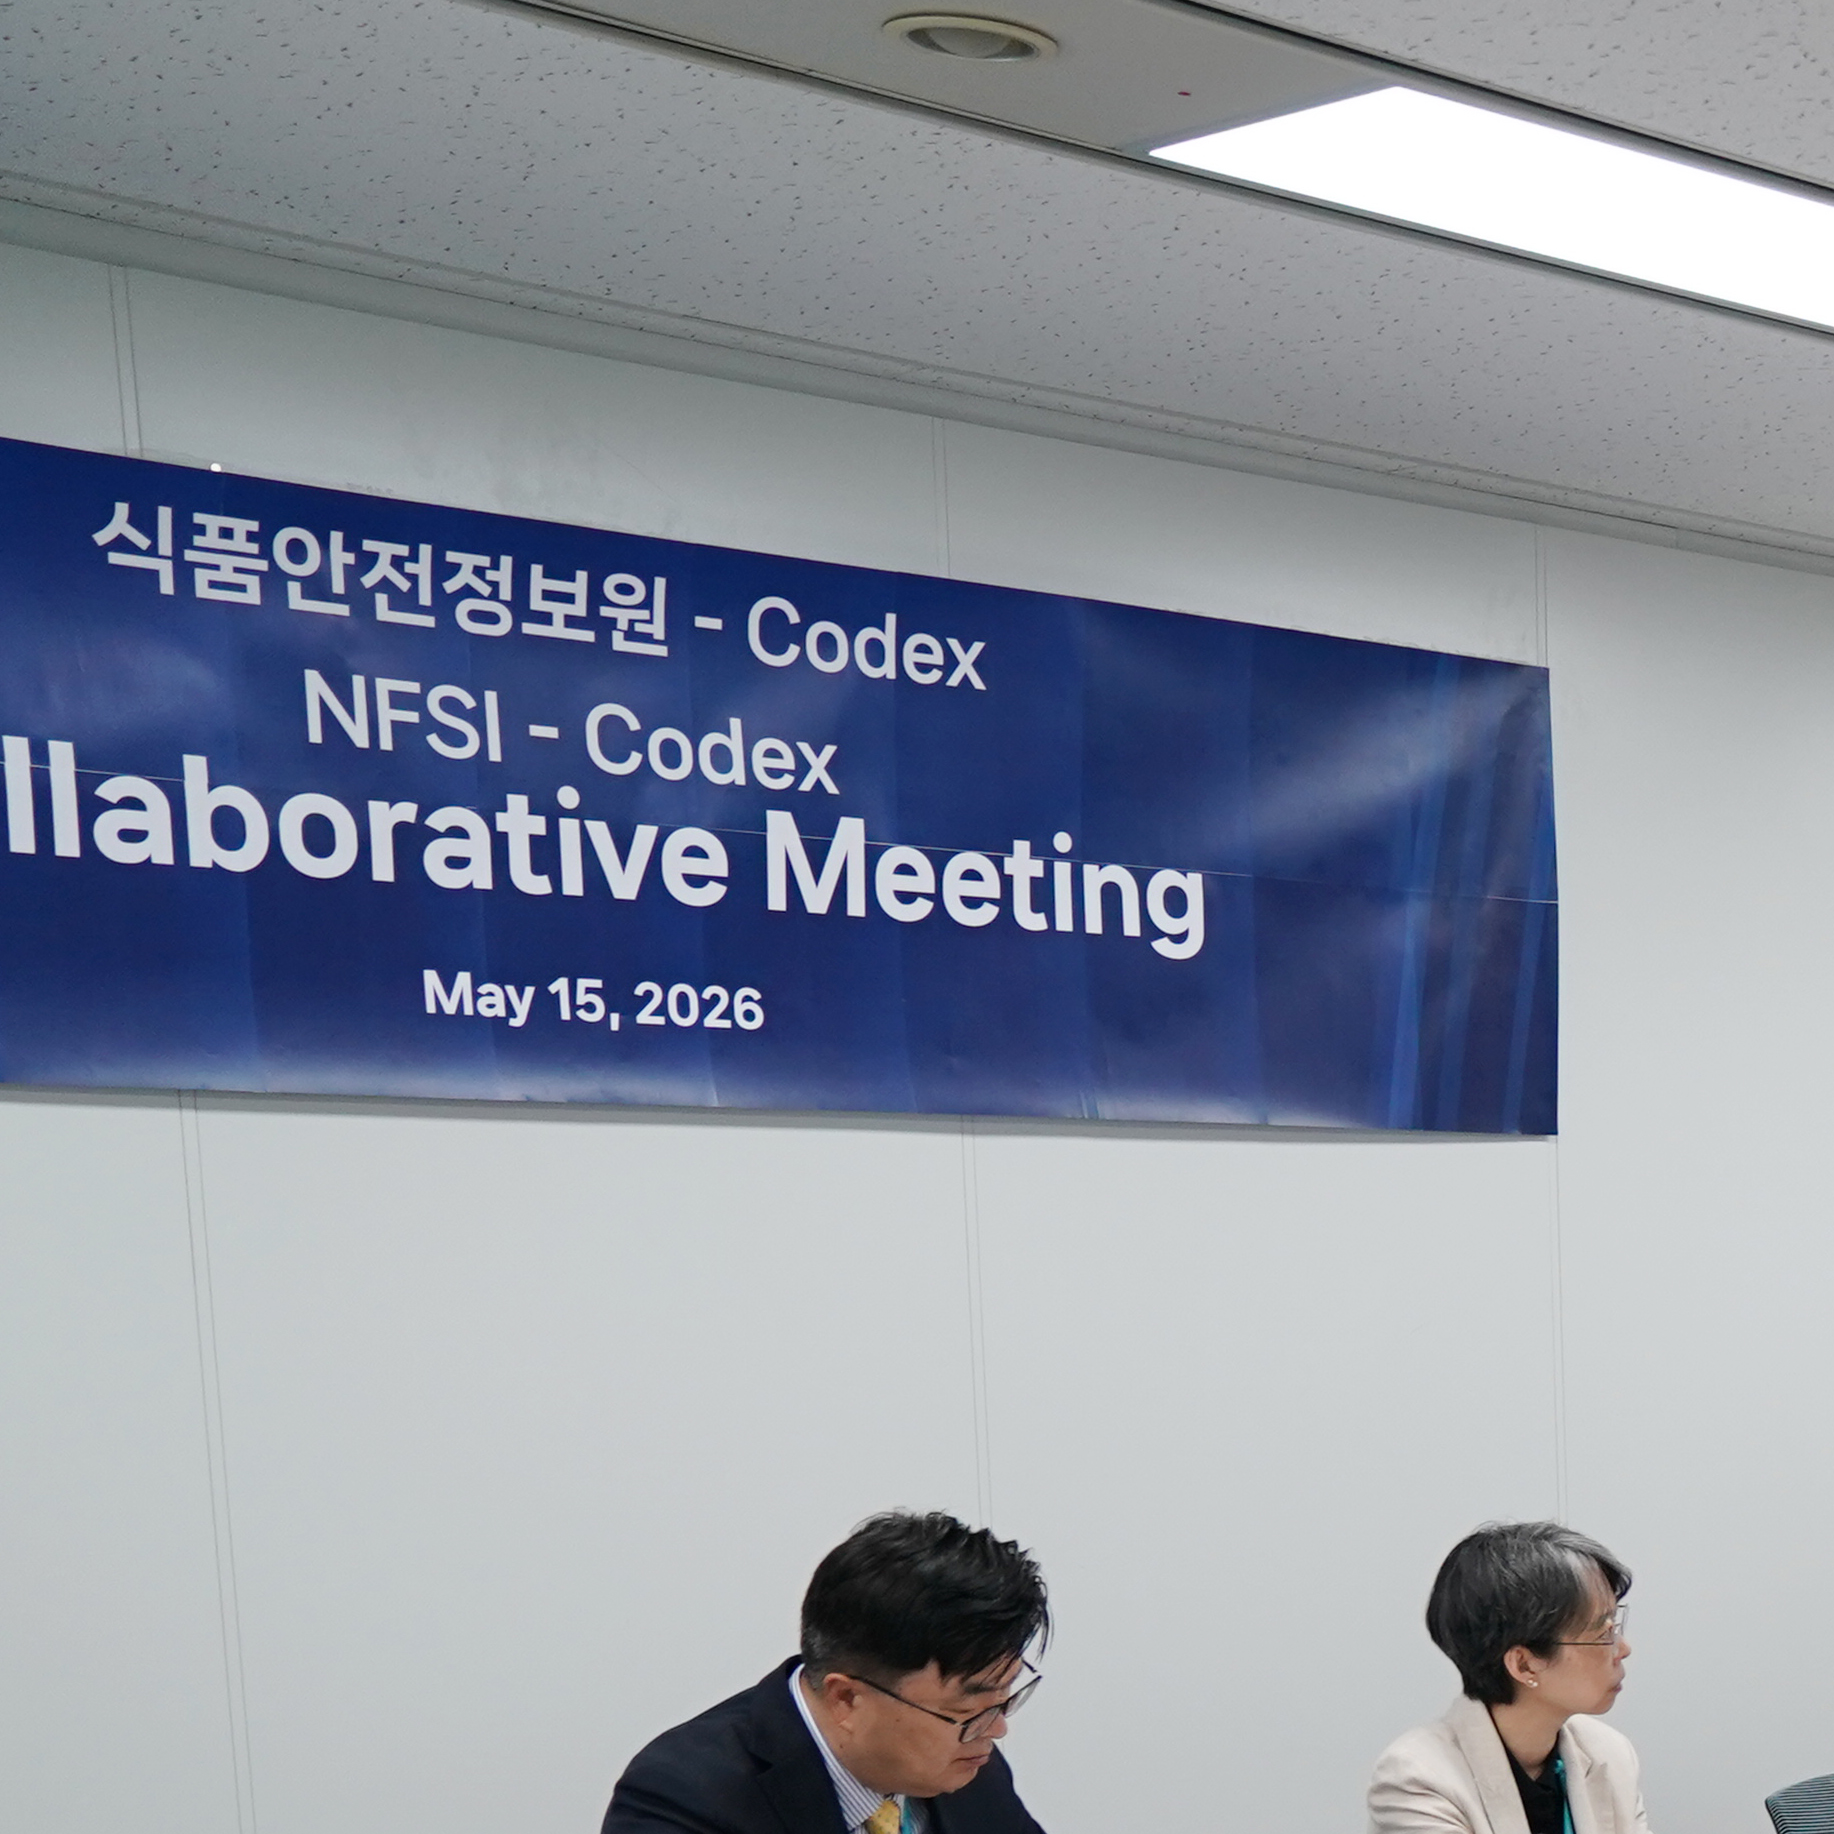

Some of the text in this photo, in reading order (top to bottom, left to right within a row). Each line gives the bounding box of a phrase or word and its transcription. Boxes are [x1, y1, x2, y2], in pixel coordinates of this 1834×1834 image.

[91, 502, 668, 657] 식품안전정보원
[748, 596, 987, 691] Codex
[303, 669, 501, 762] NFSI
[584, 702, 839, 795] Codex
[2, 735, 1204, 960] llaborative Meeting
[423, 969, 764, 1031] May 15, 2026
